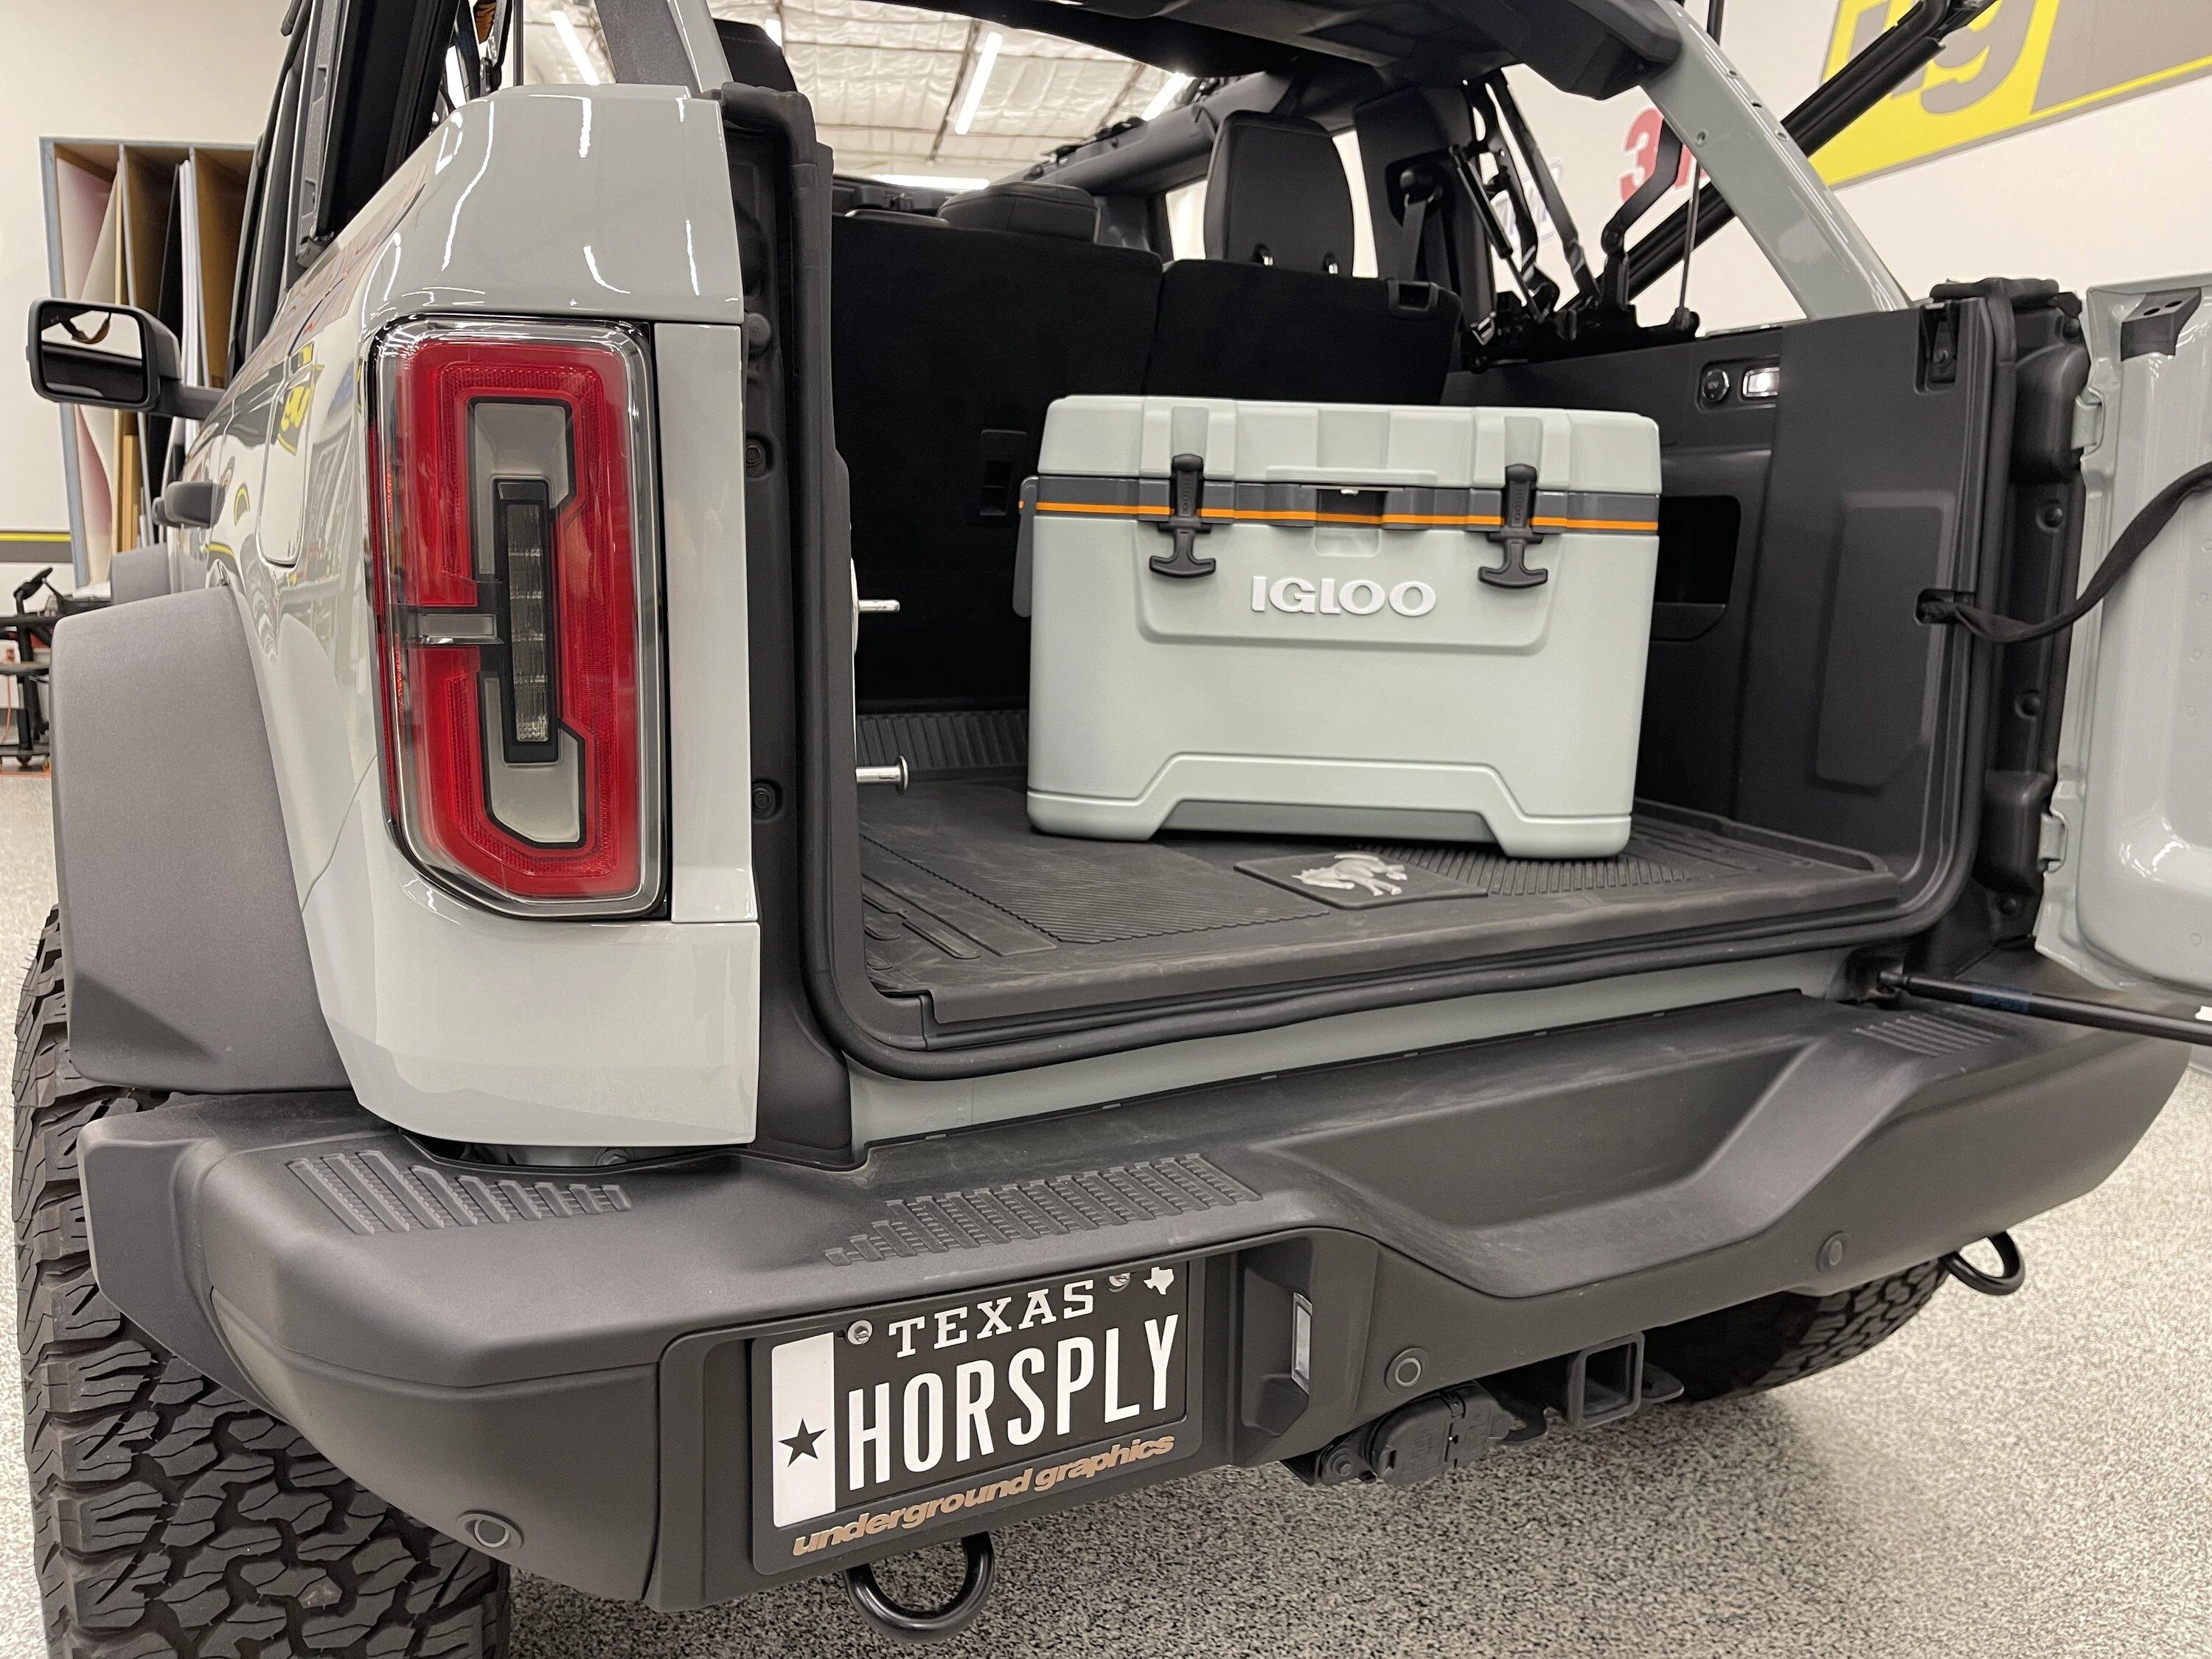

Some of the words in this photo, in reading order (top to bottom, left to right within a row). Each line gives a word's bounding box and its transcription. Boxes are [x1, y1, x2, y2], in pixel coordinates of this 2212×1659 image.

[1251, 575, 1436, 617] IGLOO
[888, 1279, 1094, 1358] TEXAS
[848, 1314, 1178, 1491] HORSPLY
[793, 1468, 1034, 1556] underground
[1034, 1436, 1175, 1492] graphics
